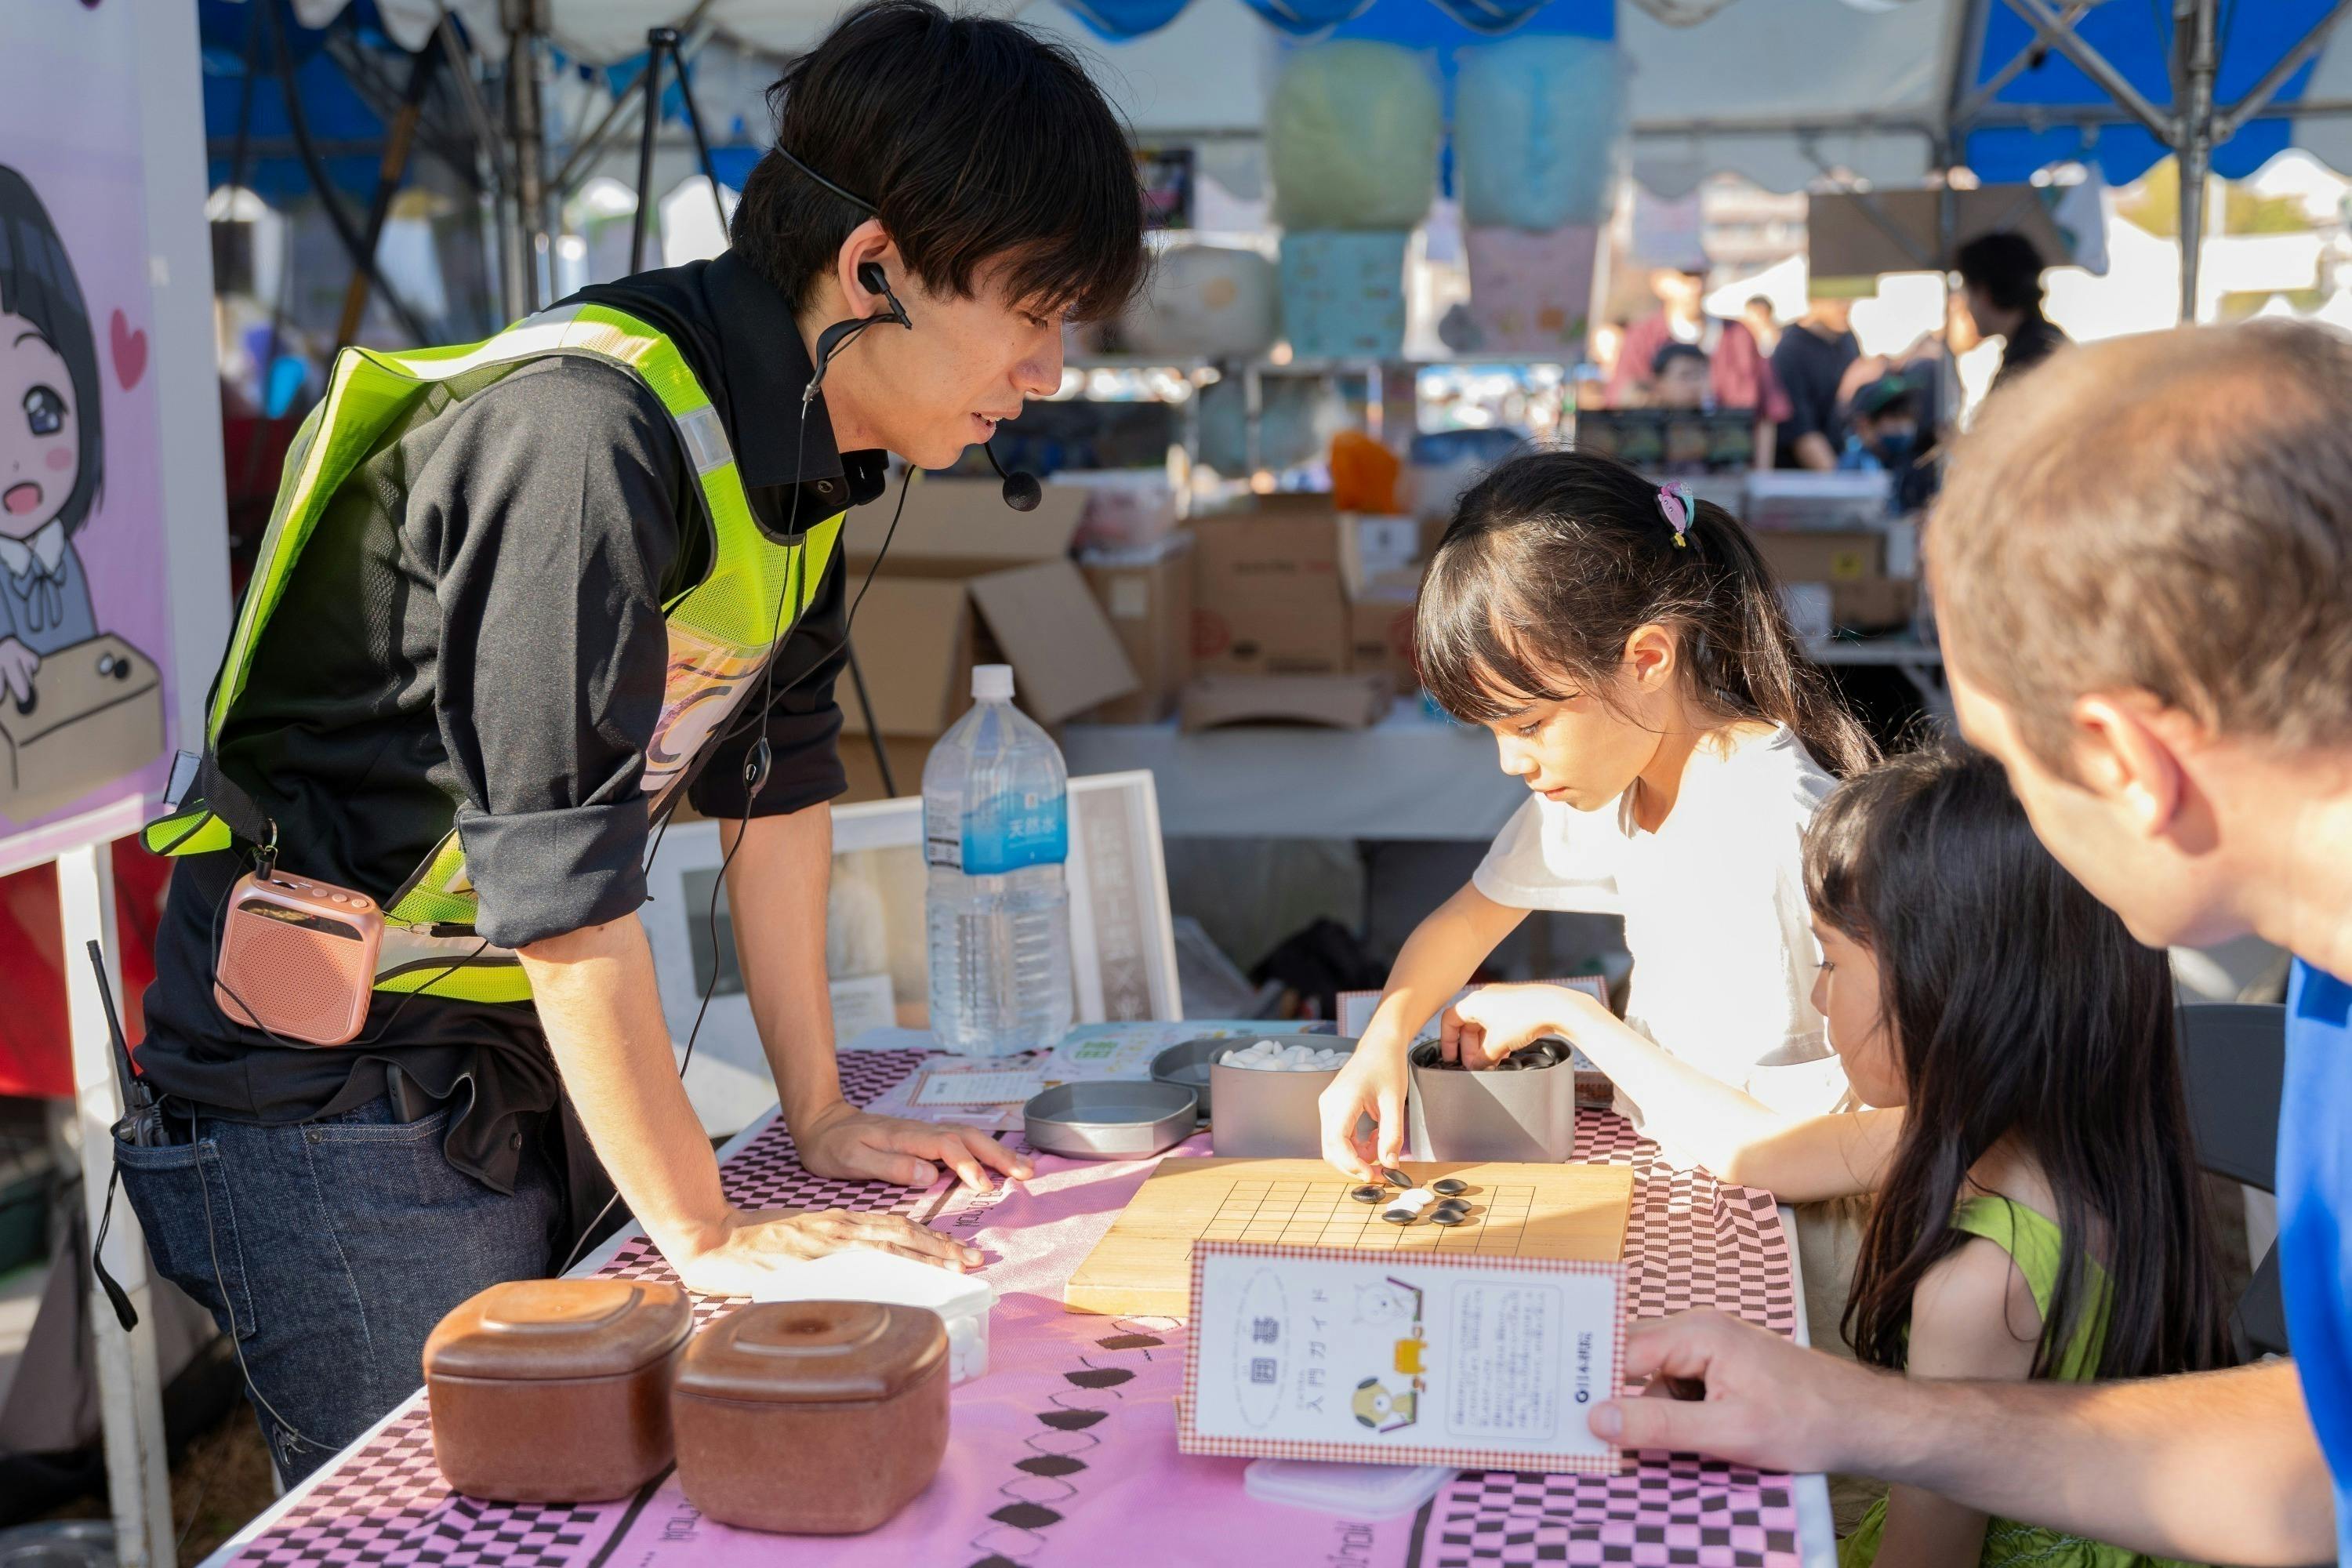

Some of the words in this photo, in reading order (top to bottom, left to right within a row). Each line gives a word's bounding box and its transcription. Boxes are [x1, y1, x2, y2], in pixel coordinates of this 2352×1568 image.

[1250, 1316, 1279, 1385] 囲碁
[1306, 1288, 1330, 1414] 入門ガイド
